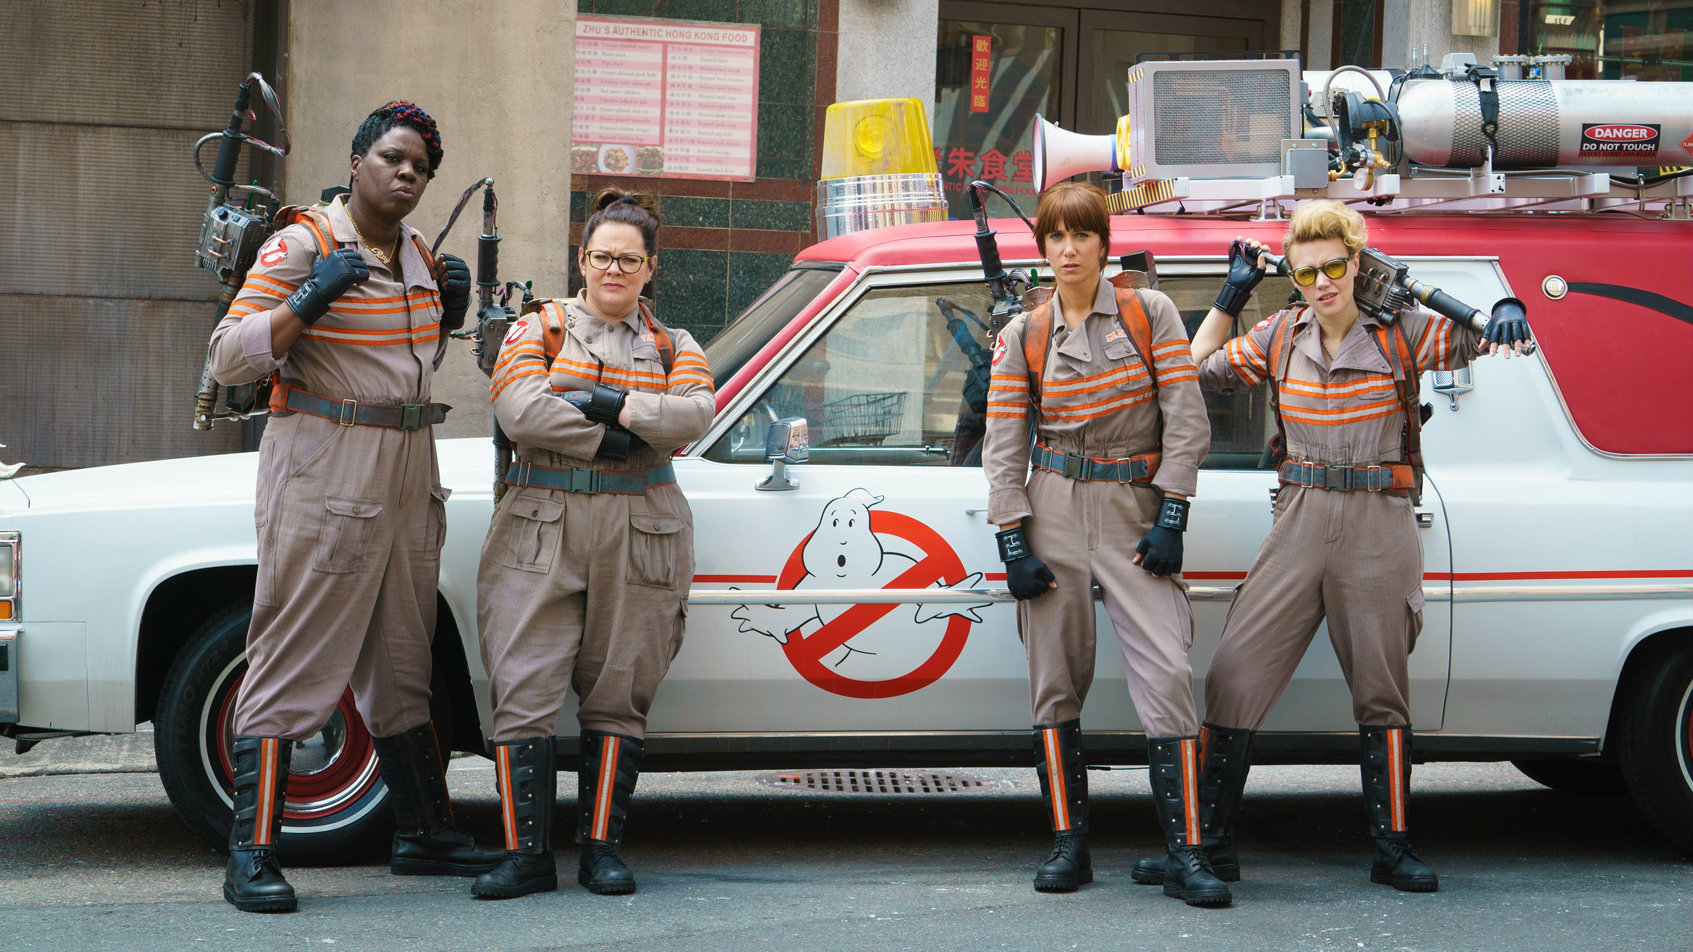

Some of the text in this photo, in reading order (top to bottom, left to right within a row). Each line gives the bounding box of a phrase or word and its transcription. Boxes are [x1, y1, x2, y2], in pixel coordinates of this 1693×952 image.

[582, 25, 748, 43] ZHU'S AUTHENTIC HONG KONG FOOD
[973, 39, 989, 108] 歡迎光臨
[1595, 128, 1648, 138] DANGER
[1622, 143, 1655, 151] TOUCH
